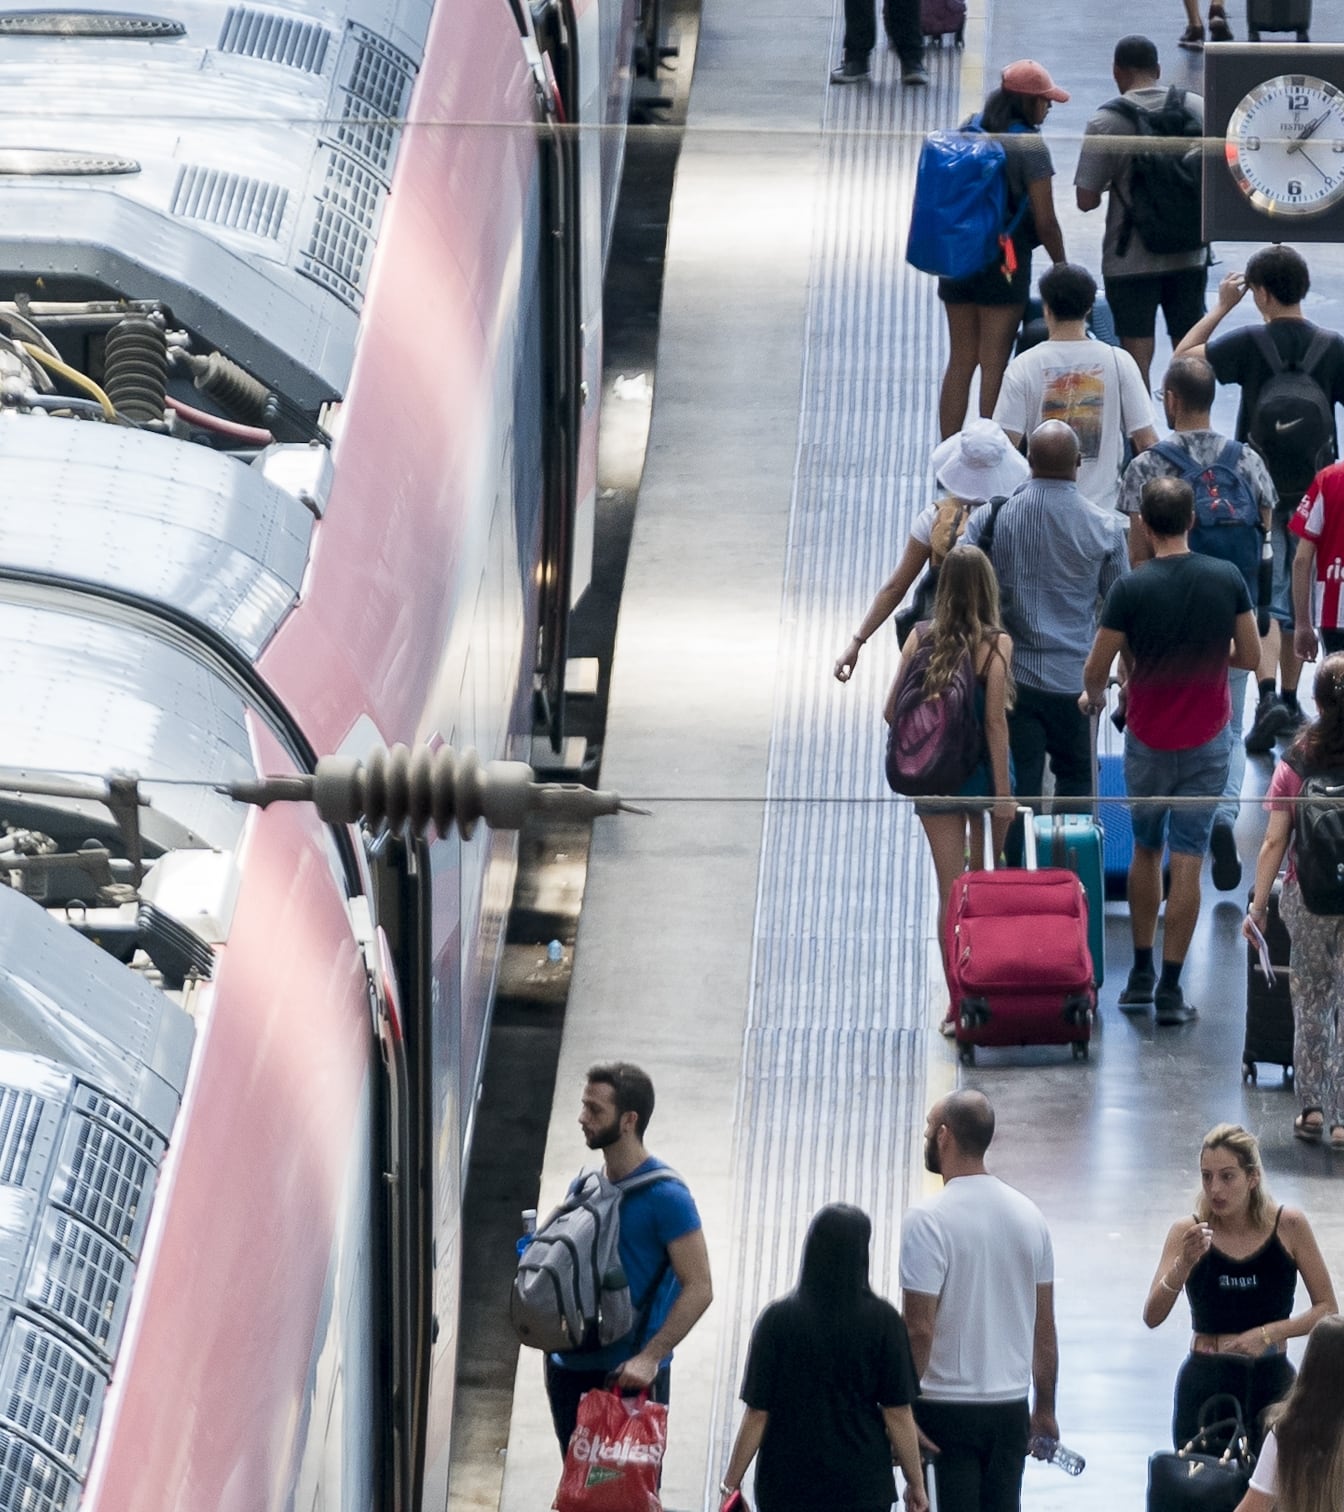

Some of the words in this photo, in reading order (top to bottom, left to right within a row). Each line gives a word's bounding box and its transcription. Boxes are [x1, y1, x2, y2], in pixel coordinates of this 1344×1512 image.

[1287, 95, 1310, 111] 12
[1280, 123, 1307, 132] FESTIN
[1287, 180, 1303, 195] 6
[1218, 1274, 1258, 1288] Angel
